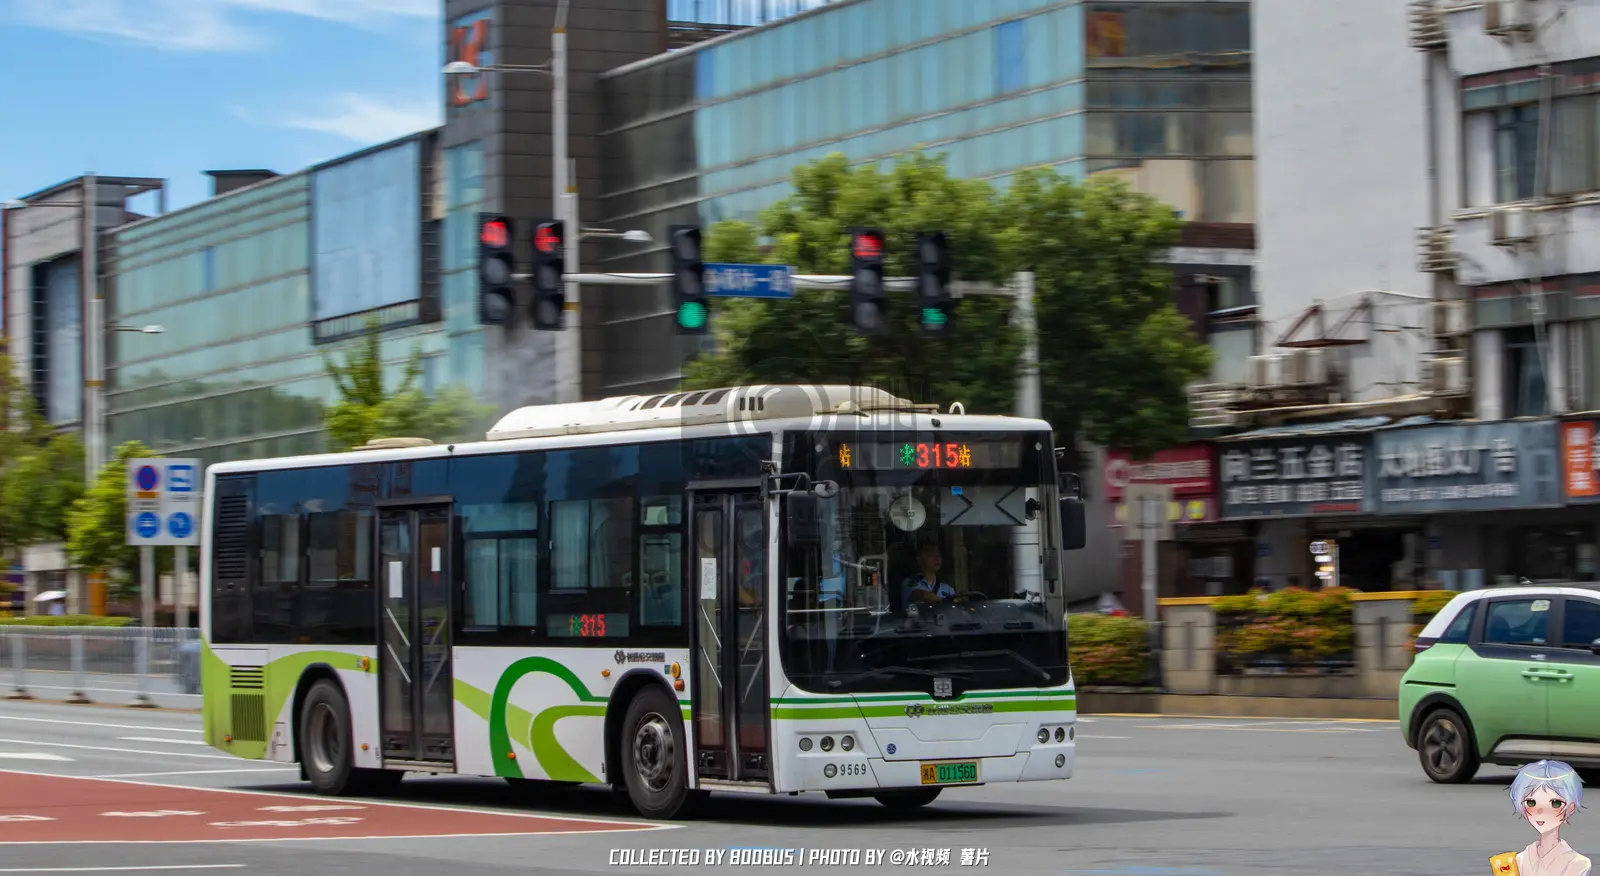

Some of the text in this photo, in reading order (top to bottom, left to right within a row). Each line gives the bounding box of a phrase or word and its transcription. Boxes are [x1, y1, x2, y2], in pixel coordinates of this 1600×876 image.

[916, 443, 959, 468] 315
[580, 614, 605, 637] 315
[840, 763, 866, 776] 9569
